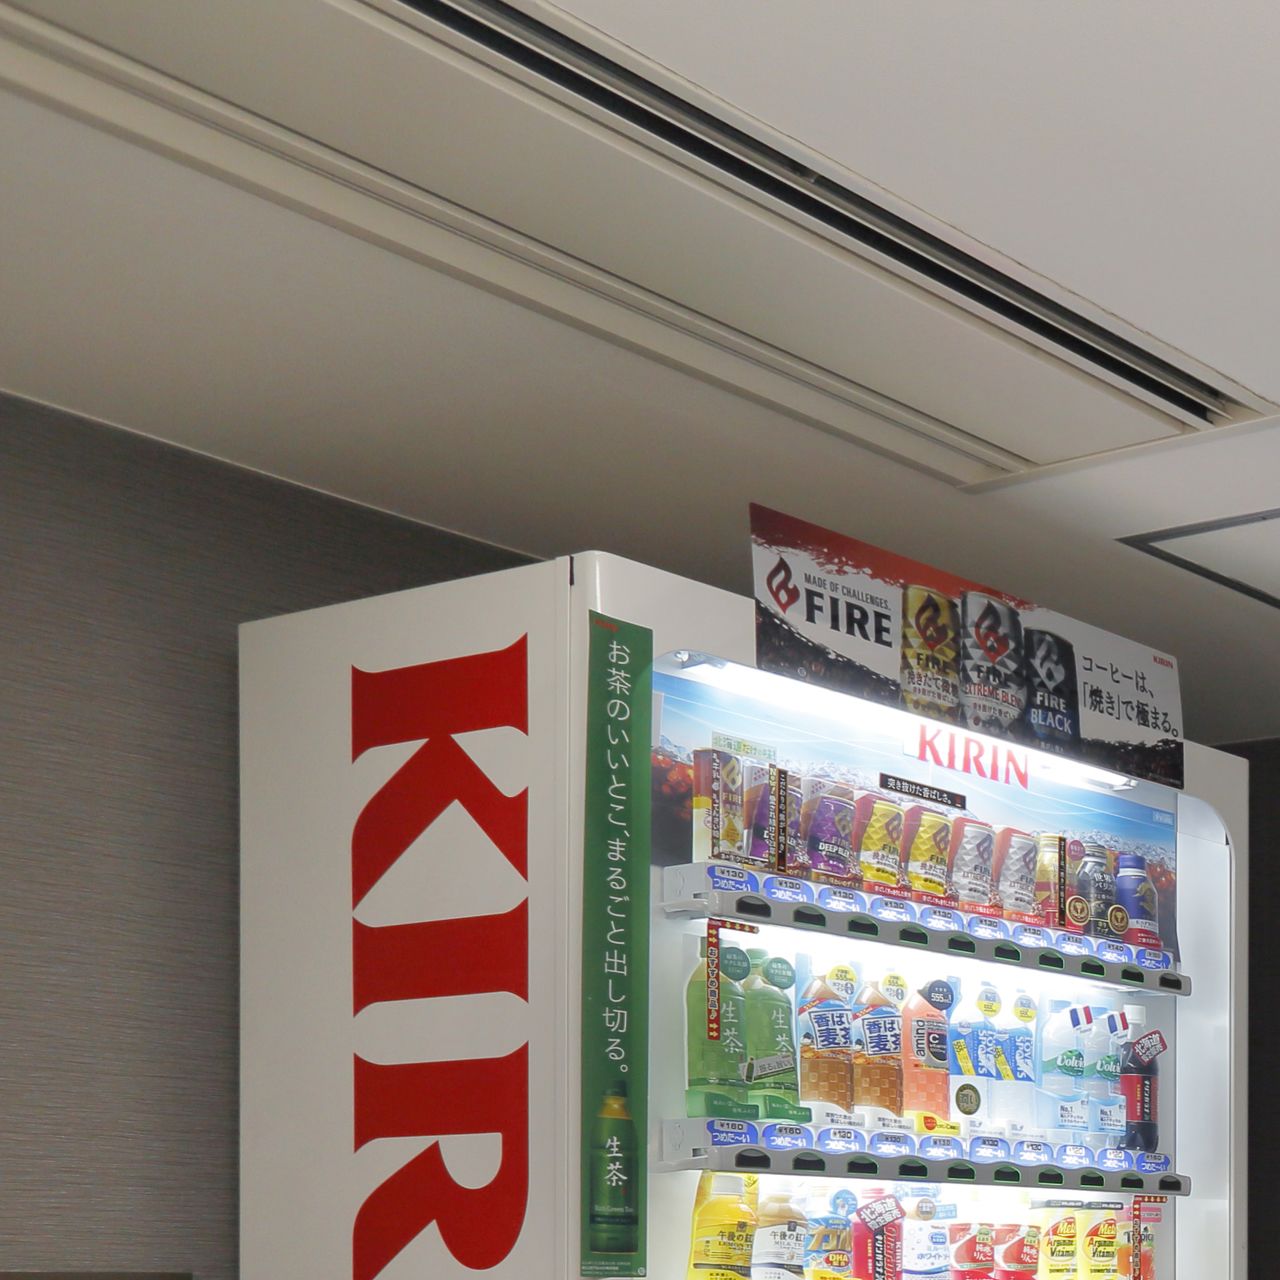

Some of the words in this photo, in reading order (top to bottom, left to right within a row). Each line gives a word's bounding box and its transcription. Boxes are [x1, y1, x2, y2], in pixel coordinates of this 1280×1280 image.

[804, 573, 827, 590] MADE
[830, 580, 839, 591] OF
[805, 588, 892, 648] FIRE
[916, 653, 952, 673] FIRE
[1083, 656, 1154, 698] コーヒーは、
[1153, 655, 1174, 669] KIRIN
[1030, 709, 1072, 734] BLACK
[1036, 691, 1066, 713] FIRE
[1083, 682, 1178, 737] 「焼き」で極まる。
[918, 724, 1028, 789] KIRIN
[601, 640, 630, 1073] お茶のいいとこ、まるごと出し切る。
[721, 1001, 743, 1053] 生茶
[915, 1020, 925, 1058] amino
[604, 1135, 628, 1187] 生茶
[861, 1198, 896, 1222] 北海道
